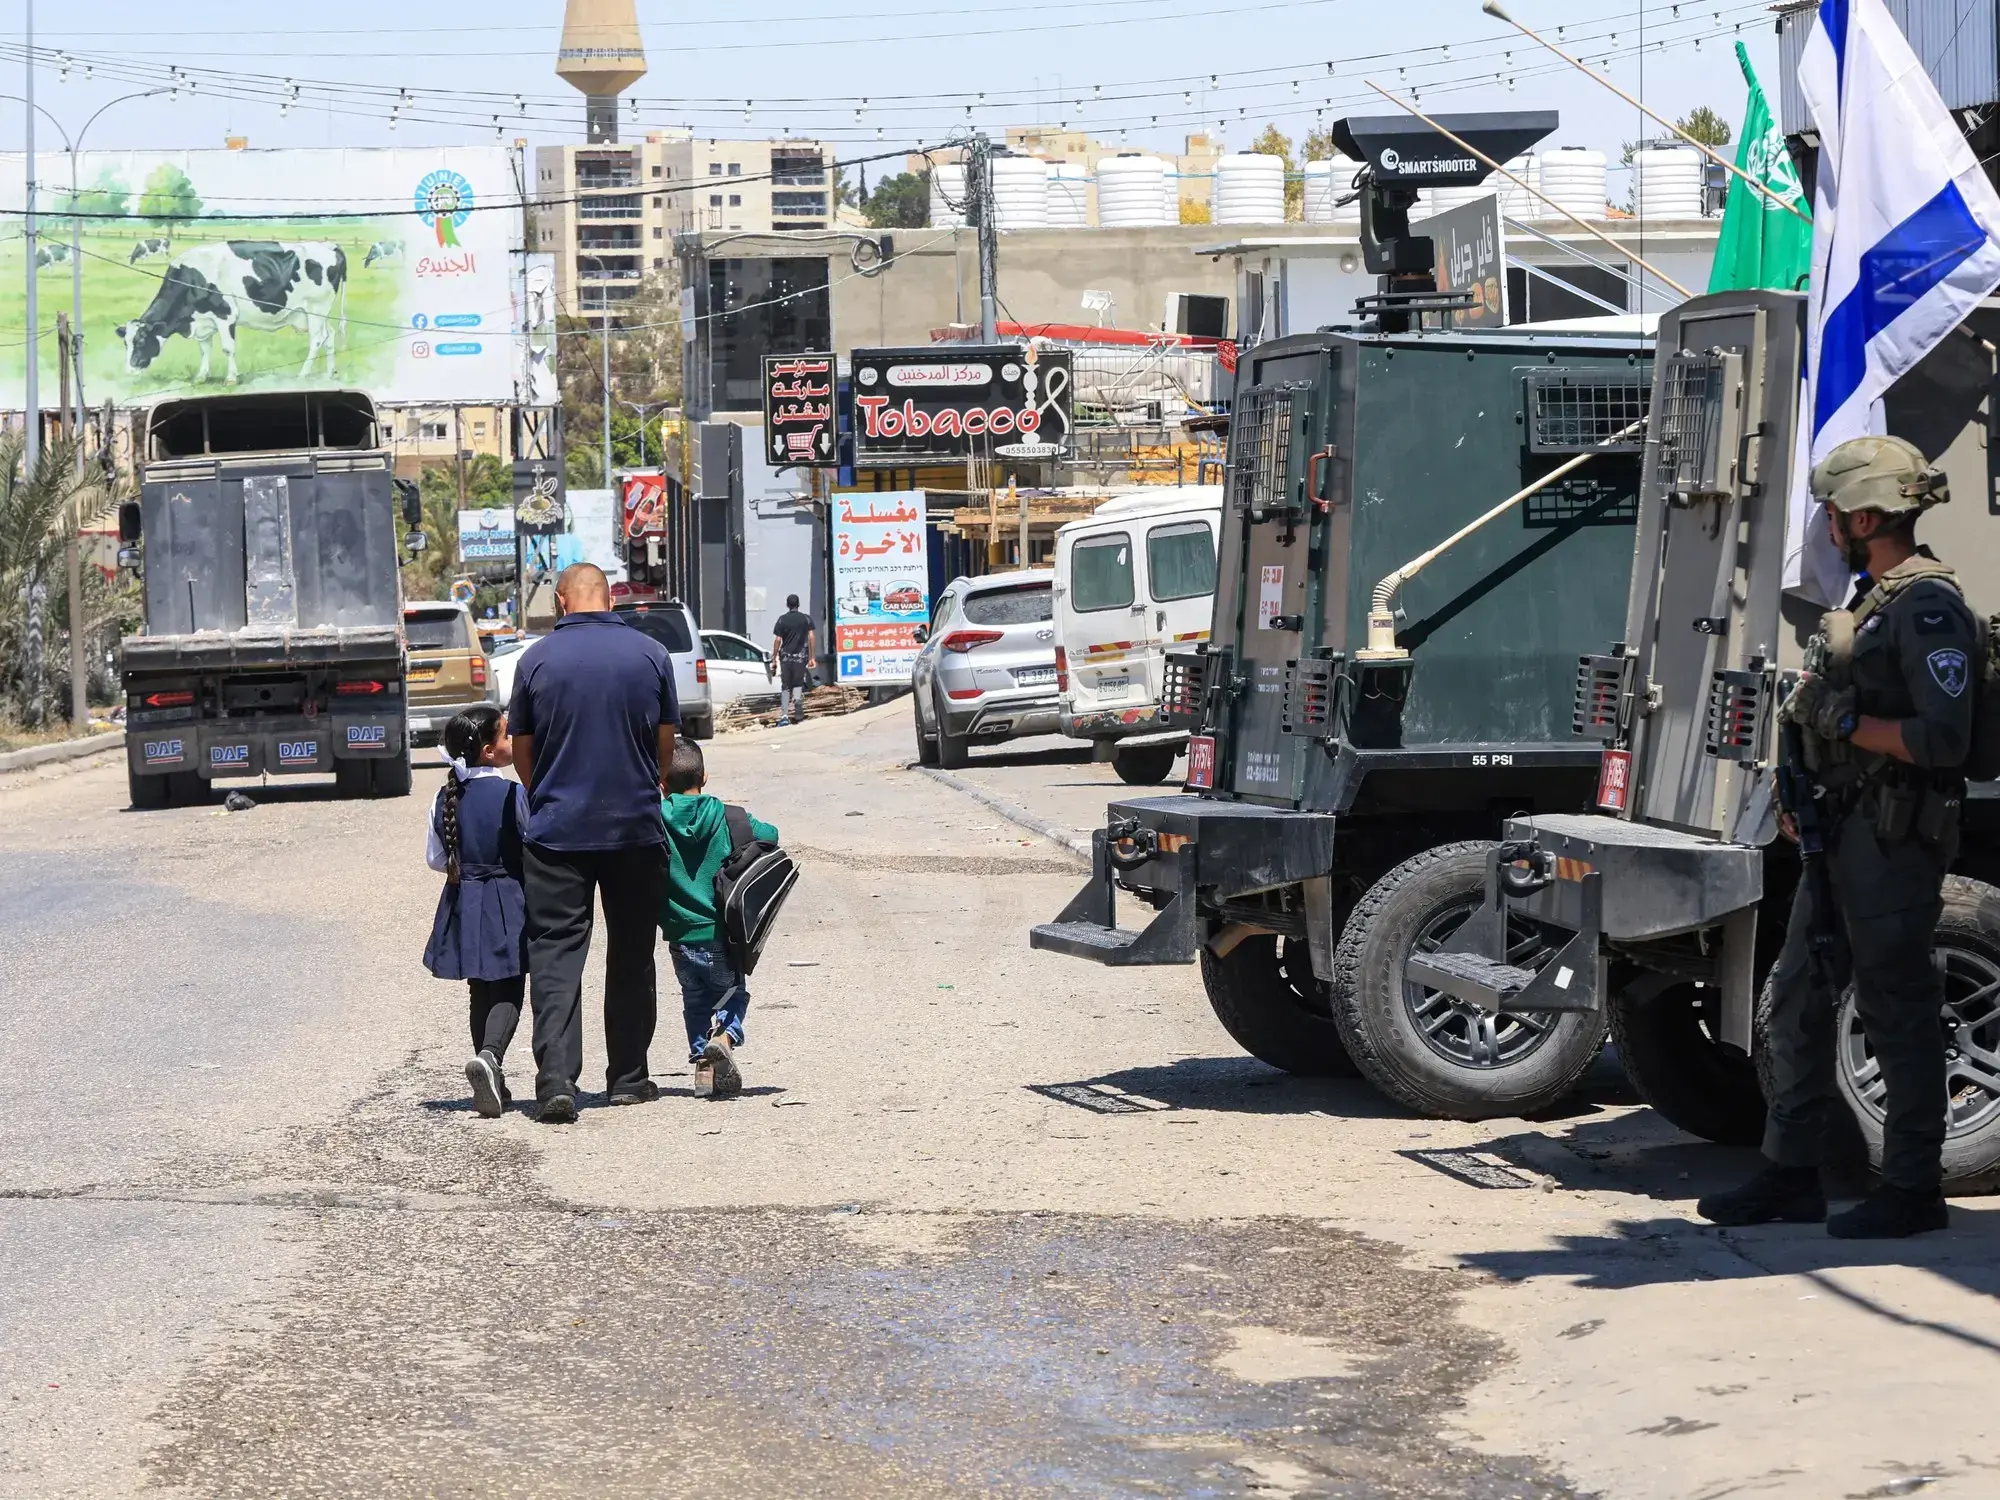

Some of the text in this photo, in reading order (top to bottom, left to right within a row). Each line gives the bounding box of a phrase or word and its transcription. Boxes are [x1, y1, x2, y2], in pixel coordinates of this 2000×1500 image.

[1398, 158, 1477, 175] SMARTSHOOTER
[1450, 214, 1494, 288] فاير جريل
[416, 253, 476, 278] الجنيدي
[770, 359, 829, 378] سوبر
[896, 365, 982, 384] مركز المدخنين
[772, 380, 830, 400] ماركت
[856, 394, 1041, 437] Tobacco
[838, 499, 918, 524] مغسلة
[837, 528, 921, 562] الأخوة
[883, 602, 924, 611] CAR WASH
[879, 665, 913, 674] Parkin
[347, 726, 386, 742] DAF
[144, 740, 182, 757] DAF
[211, 745, 248, 762] DAF
[279, 742, 317, 758] DAF
[1472, 754, 1513, 766] 55 PSI
